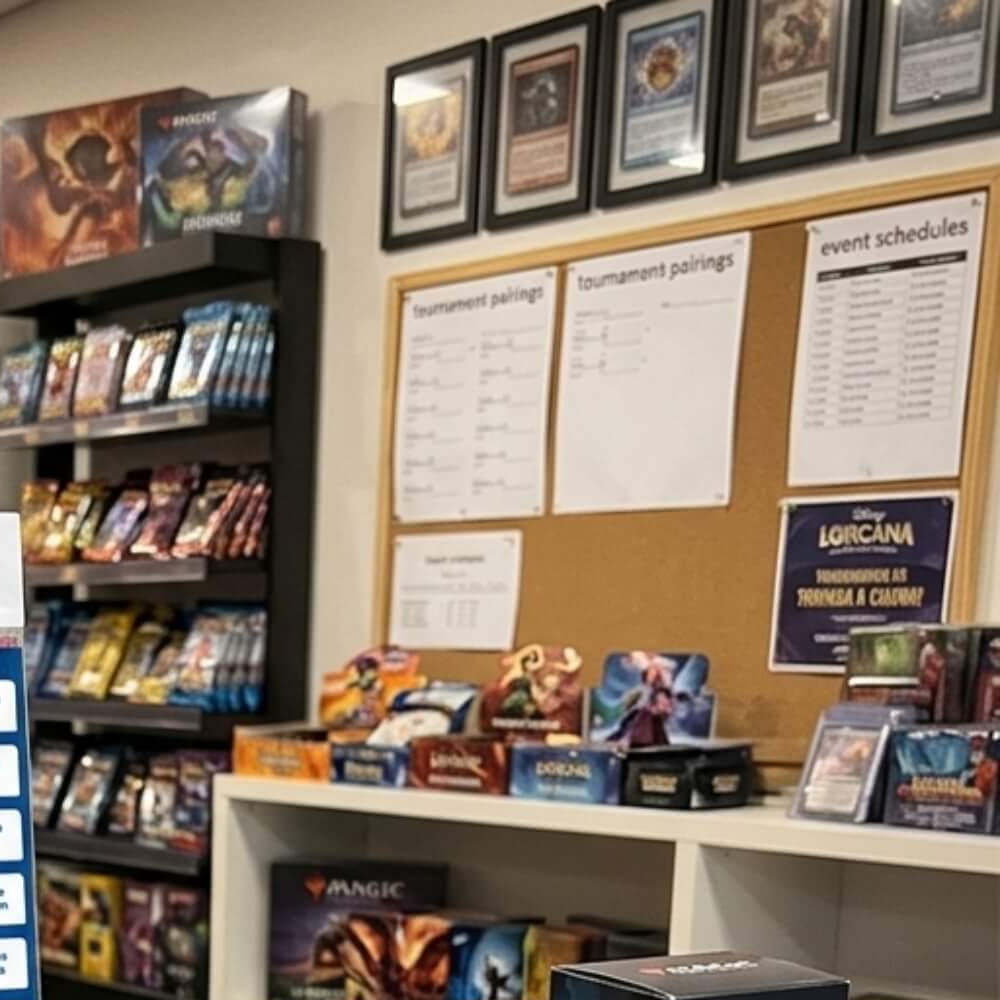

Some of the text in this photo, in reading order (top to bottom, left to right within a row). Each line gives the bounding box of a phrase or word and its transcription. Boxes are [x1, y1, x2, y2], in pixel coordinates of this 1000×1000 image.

[821, 218, 969, 256] event schedules
[578, 262, 667, 291] tournament
[818, 522, 915, 548] LORCANA
